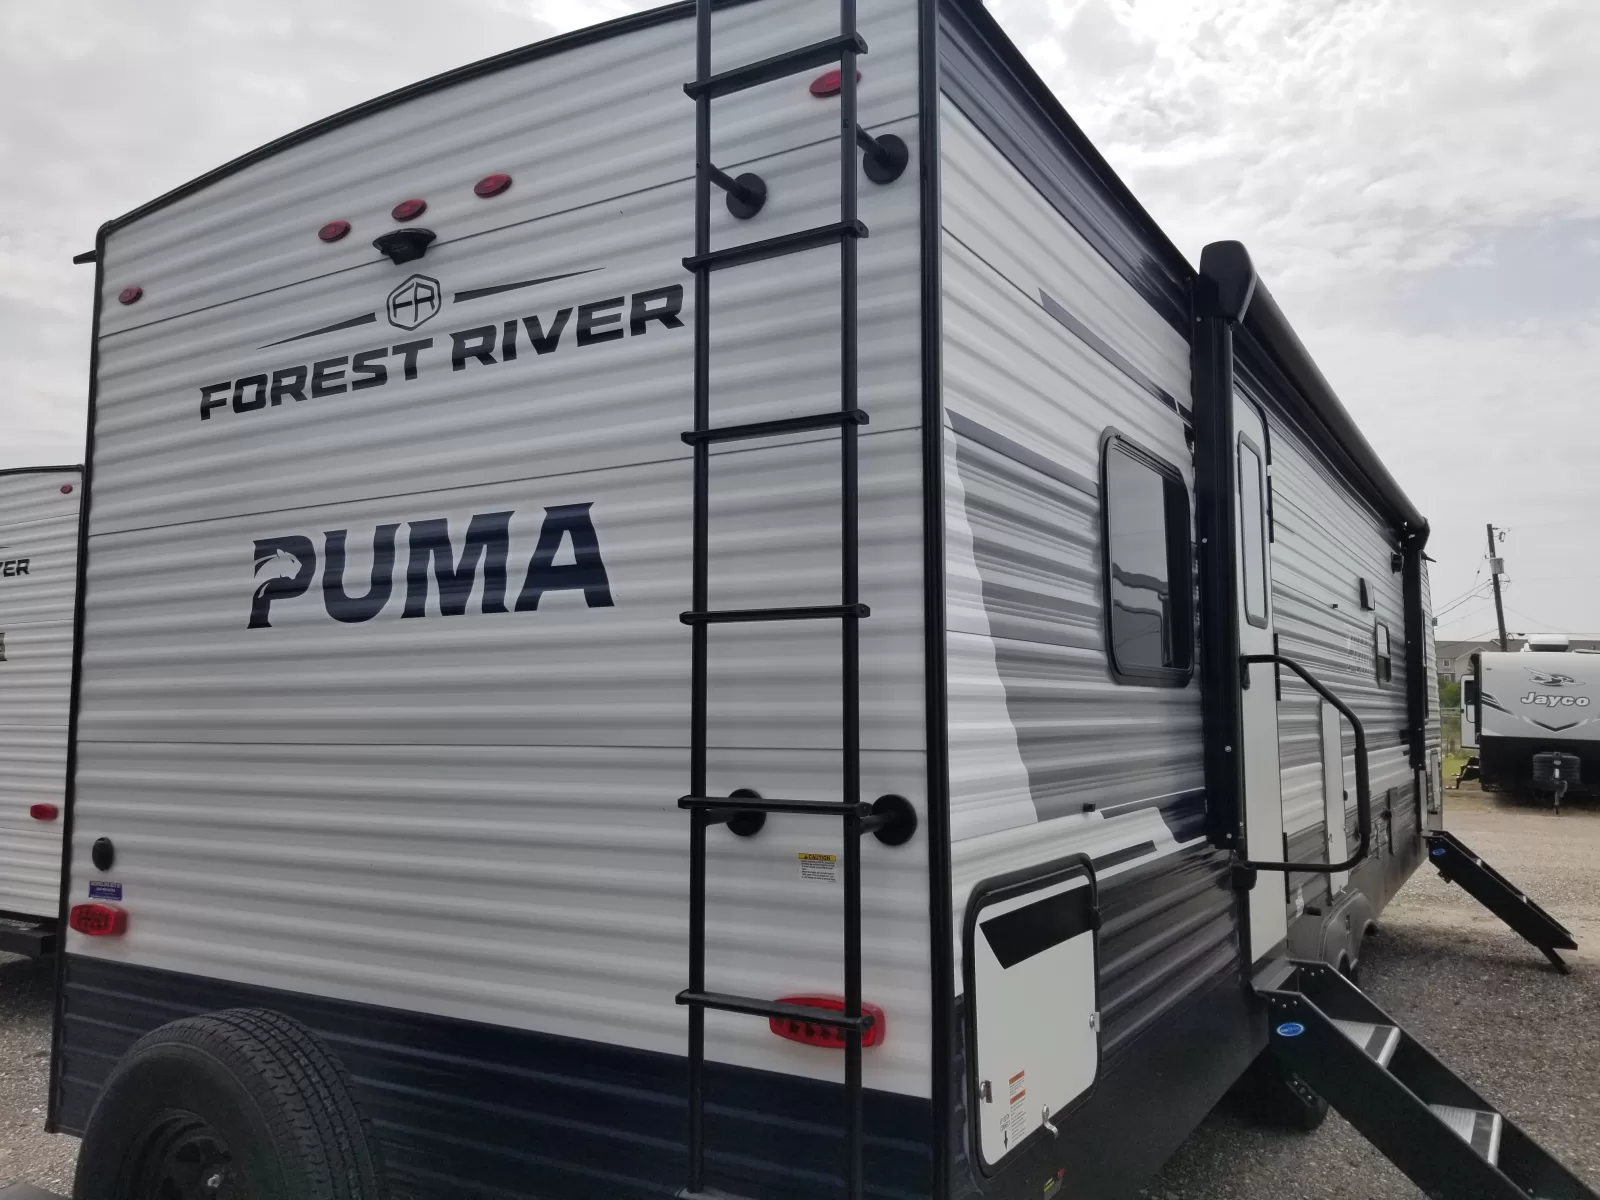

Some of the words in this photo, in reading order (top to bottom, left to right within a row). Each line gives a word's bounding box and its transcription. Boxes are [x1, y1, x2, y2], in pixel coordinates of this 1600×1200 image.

[199, 337, 434, 422] FOREST
[448, 284, 686, 372] RIVER
[247, 501, 615, 630] PUMA
[1520, 691, 1591, 708] Jayco
